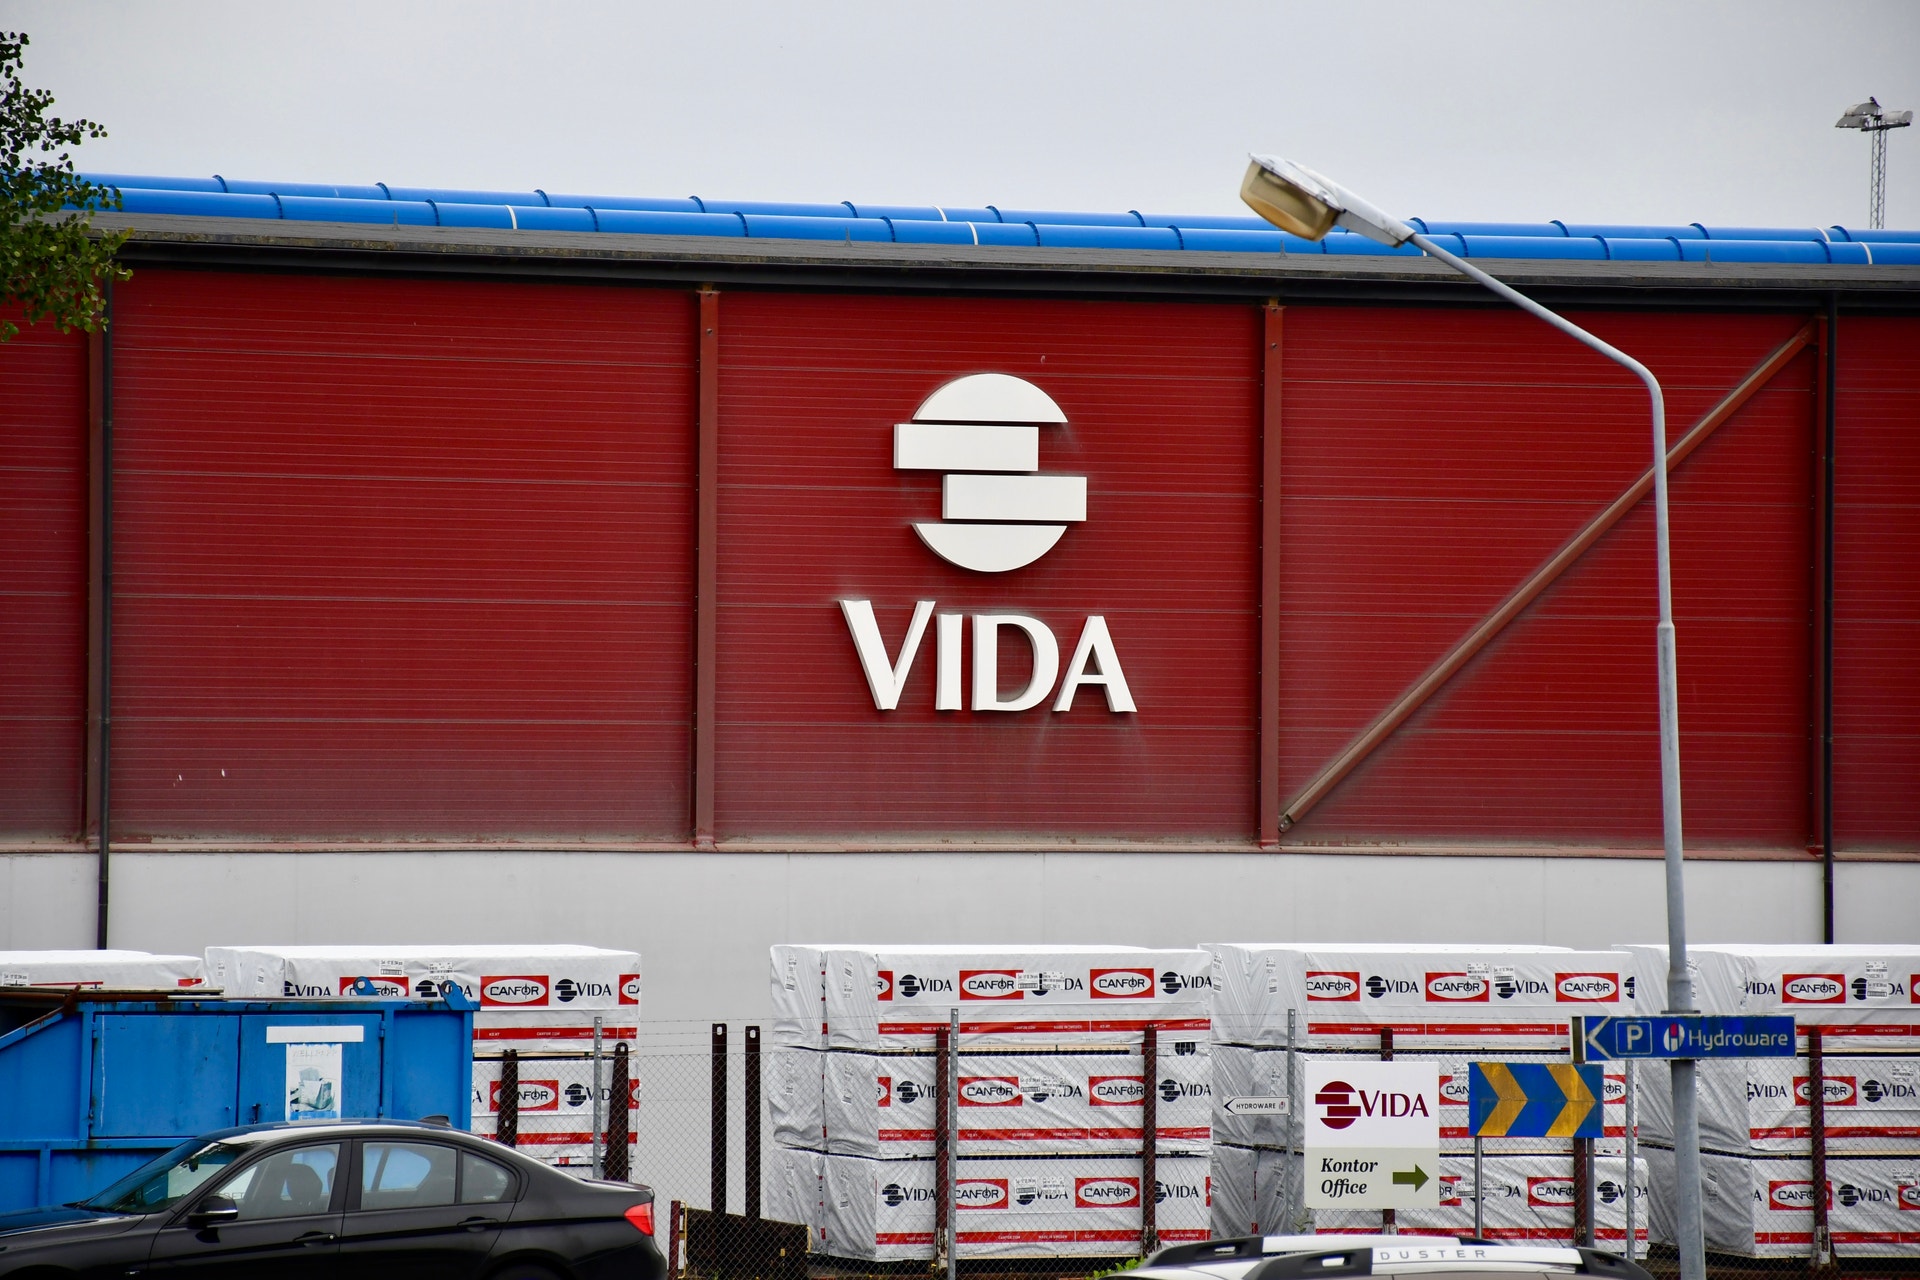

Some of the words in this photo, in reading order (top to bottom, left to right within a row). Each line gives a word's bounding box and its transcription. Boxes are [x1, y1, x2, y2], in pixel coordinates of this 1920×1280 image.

[838, 600, 1138, 713] VIDA
[919, 977, 953, 992] VIDA
[968, 979, 1015, 991] CANFOR
[1099, 978, 1145, 990] CANFOR
[1180, 974, 1213, 989] VIDA
[1307, 980, 1351, 993] CANFOR
[1385, 979, 1419, 993] VIDA
[1434, 981, 1480, 993] CANFOR
[1515, 980, 1550, 994] VIDA
[1564, 981, 1611, 994] CANFOR
[295, 984, 332, 997] VIDA
[490, 985, 539, 997] CANFOR
[577, 982, 612, 997] VIDA
[1791, 983, 1837, 995] CANFOR
[1627, 1025, 1643, 1050] P
[1688, 1029, 1789, 1051] Hydroware
[518, 1089, 549, 1101] NFOR
[967, 1086, 1014, 1098] CANFOR
[1097, 1085, 1144, 1097] CANFOR
[1179, 1083, 1212, 1097] VIDA
[1446, 1085, 1469, 1095] CAN
[1753, 1083, 1788, 1098] VIDA
[1802, 1085, 1848, 1098] CFOR
[1882, 1083, 1917, 1098] VIDA
[1358, 1089, 1430, 1118] VIDA
[1320, 1158, 1379, 1173] Kontor
[902, 1187, 937, 1201] VIDA
[1084, 1186, 1131, 1199] CANFOR
[1166, 1184, 1199, 1199] VIDA
[1321, 1179, 1368, 1198] Office
[1537, 1184, 1575, 1198] CANFO
[1617, 1184, 1648, 1198] VDA
[1858, 1188, 1892, 1202] VIDA
[1778, 1190, 1815, 1202] CANFO
[1380, 1249, 1486, 1261] DUSTER
